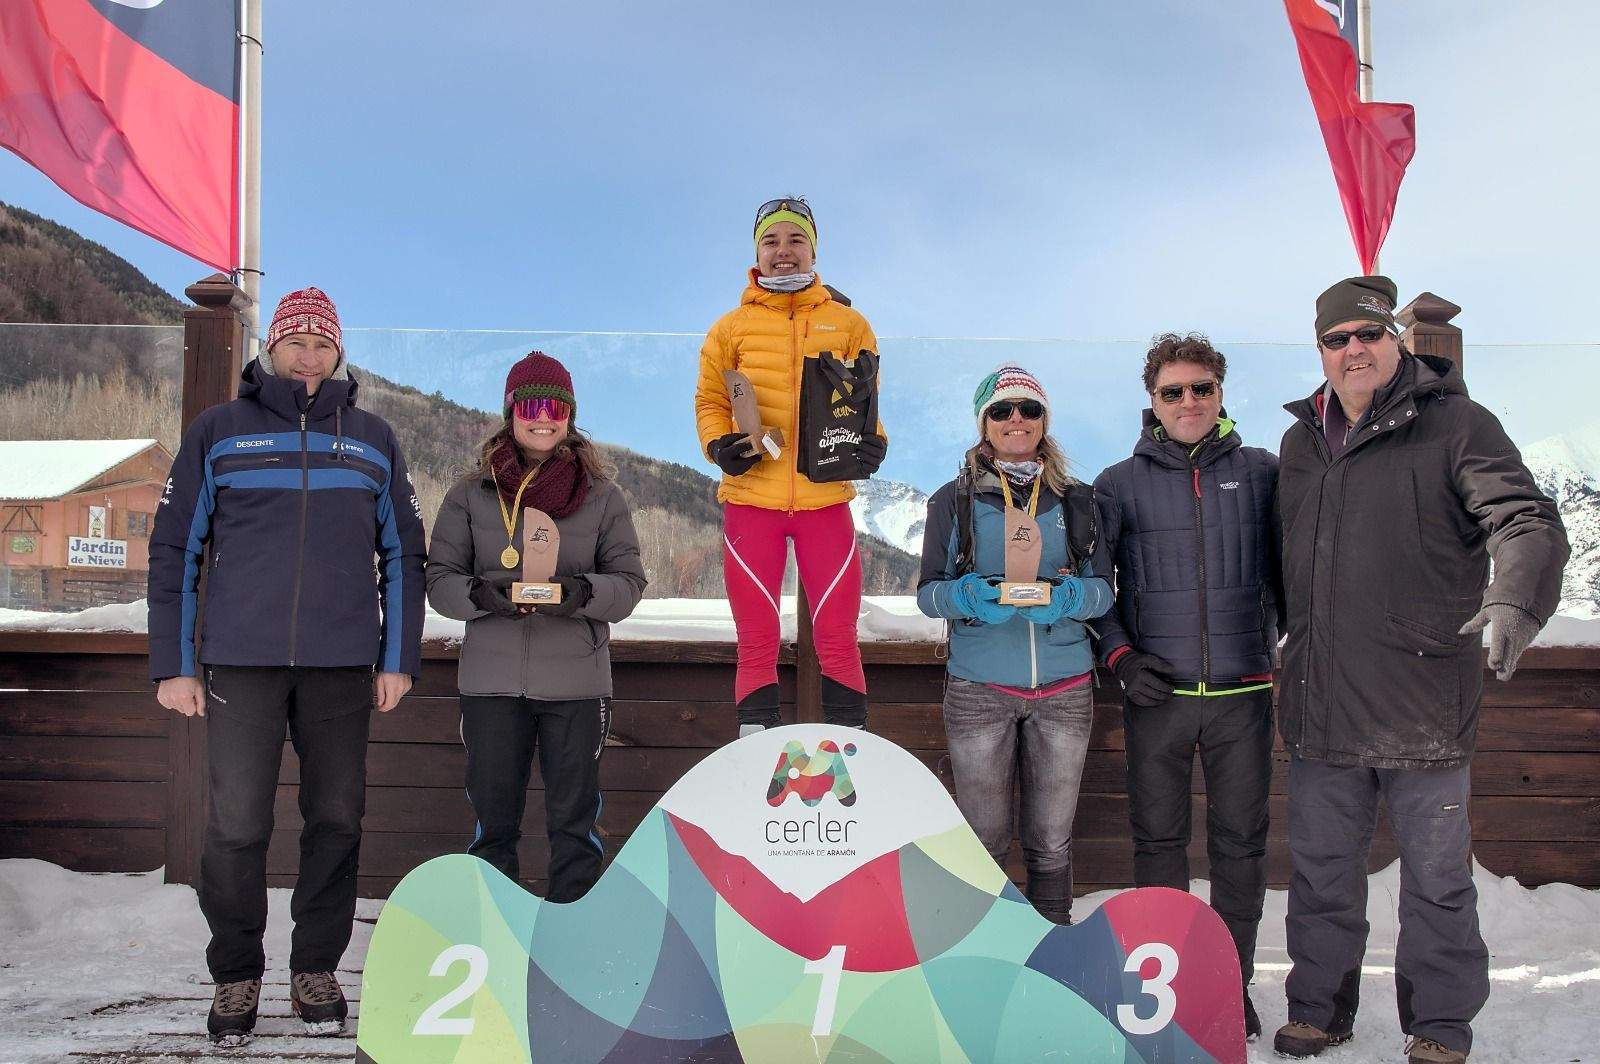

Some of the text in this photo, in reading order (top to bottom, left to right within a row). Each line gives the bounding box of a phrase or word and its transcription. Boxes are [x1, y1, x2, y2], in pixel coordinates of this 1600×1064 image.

[236, 439, 274, 448] DESCENTE
[71, 555, 125, 566] de Nieve
[765, 811, 858, 844] cerler
[767, 848, 856, 857] UNA MONTAÑA DE ARAMÓN
[412, 944, 490, 1036] 2
[803, 945, 847, 1036] 1
[1116, 942, 1180, 1036] 3
